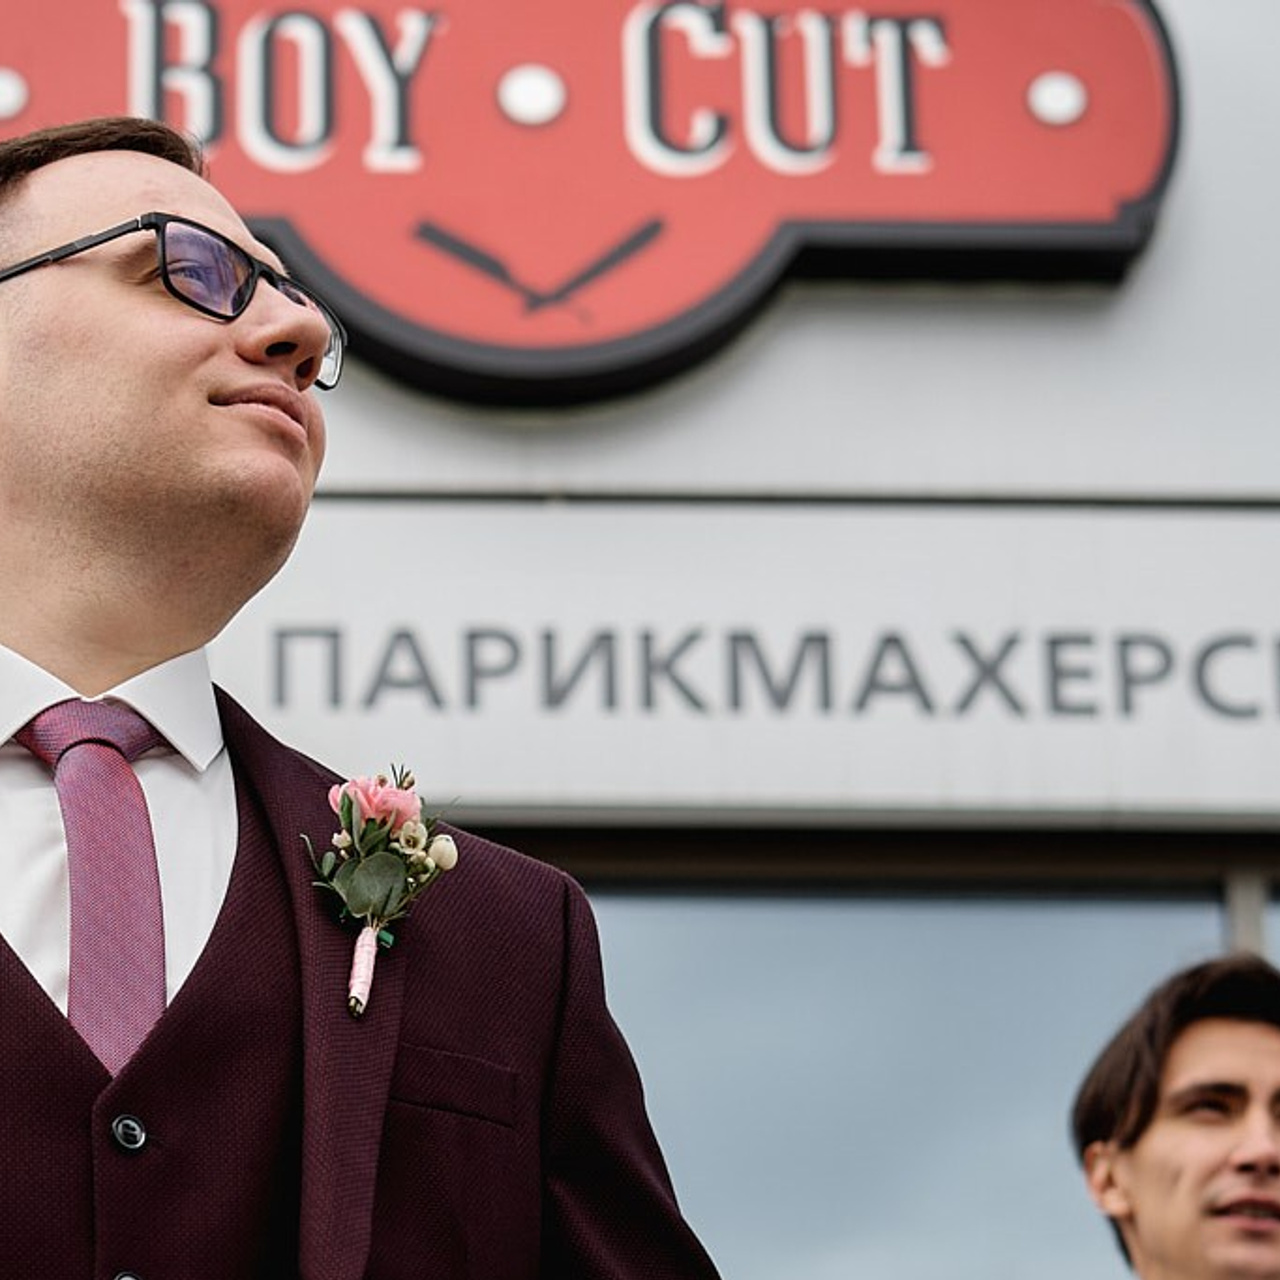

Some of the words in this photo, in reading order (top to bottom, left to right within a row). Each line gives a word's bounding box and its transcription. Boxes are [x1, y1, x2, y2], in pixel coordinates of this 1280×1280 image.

[121, 0, 447, 174] BOY
[621, 0, 950, 178] CUT
[272, 627, 1280, 719] ПАРИКМАХЕРС
